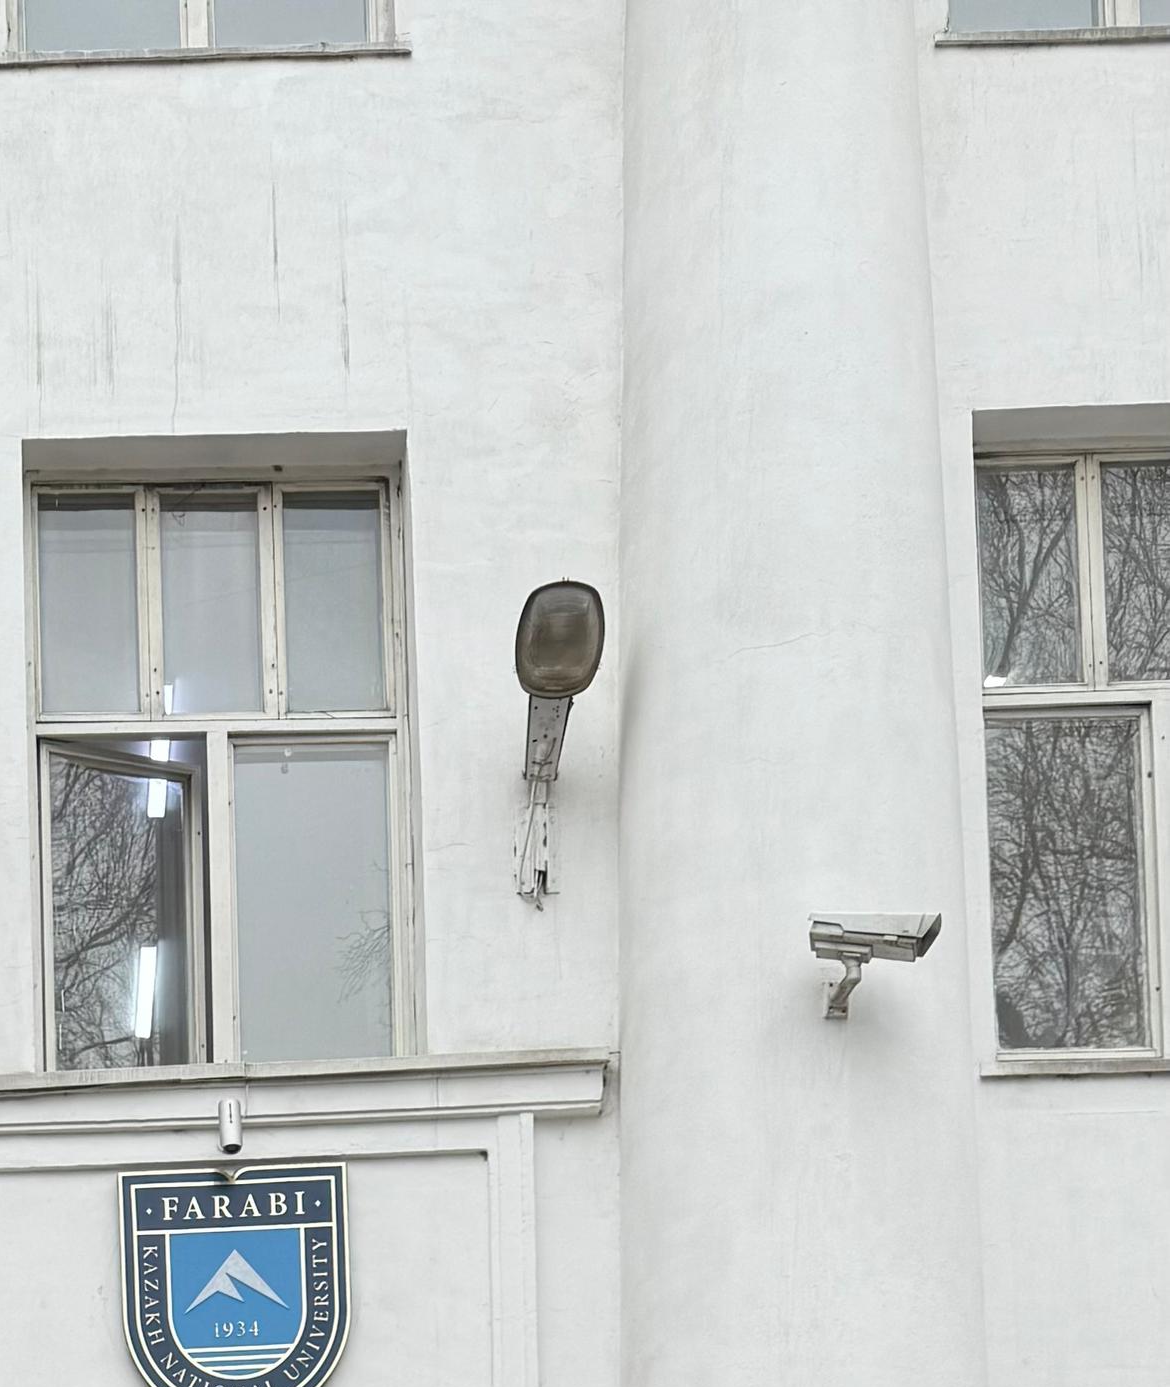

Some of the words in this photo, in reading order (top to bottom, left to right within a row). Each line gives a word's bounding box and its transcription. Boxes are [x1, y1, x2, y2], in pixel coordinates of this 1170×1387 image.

[162, 1191, 306, 1221] FARABI
[142, 1245, 165, 1347] KAZAKH
[283, 1239, 330, 1381] UNIVERSITY
[214, 1321, 260, 1338] 1934
